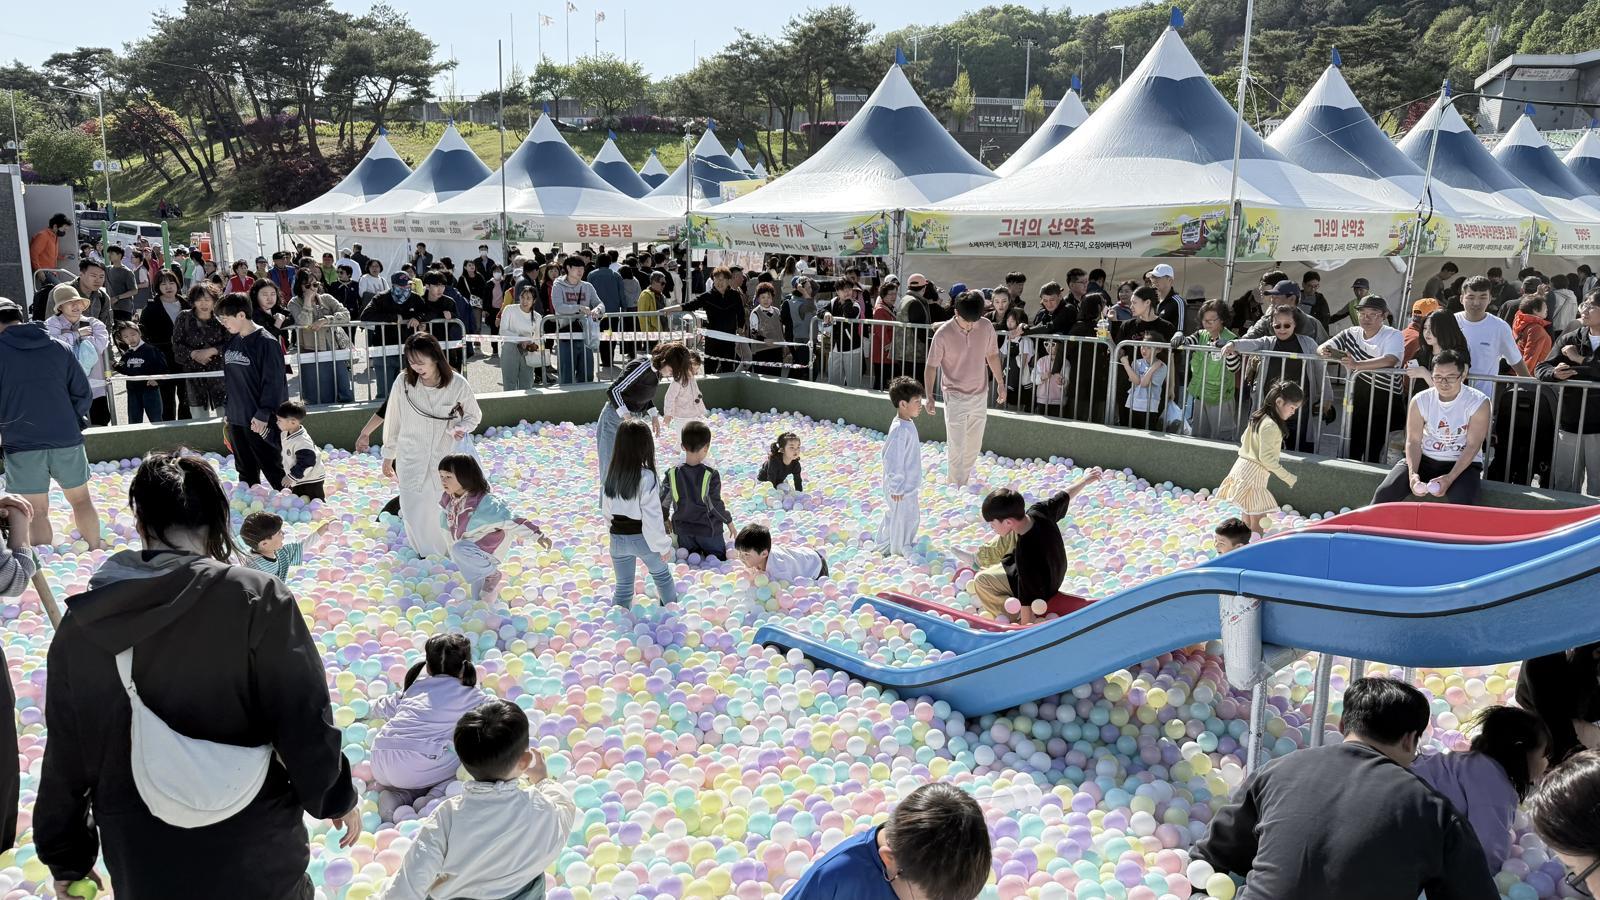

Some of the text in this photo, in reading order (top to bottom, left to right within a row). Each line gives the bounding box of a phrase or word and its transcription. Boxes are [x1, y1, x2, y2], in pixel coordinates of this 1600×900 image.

[350, 217, 388, 233] 향토음식점
[576, 223, 633, 238] 향토음식점
[783, 223, 805, 238] 가게
[999, 217, 1096, 236] 그녀의 산약초
[1313, 218, 1365, 238] 그녀의 산약초
[1063, 241, 1087, 250] 치즈구이,
[1088, 241, 1132, 249] 오징어버터구이
